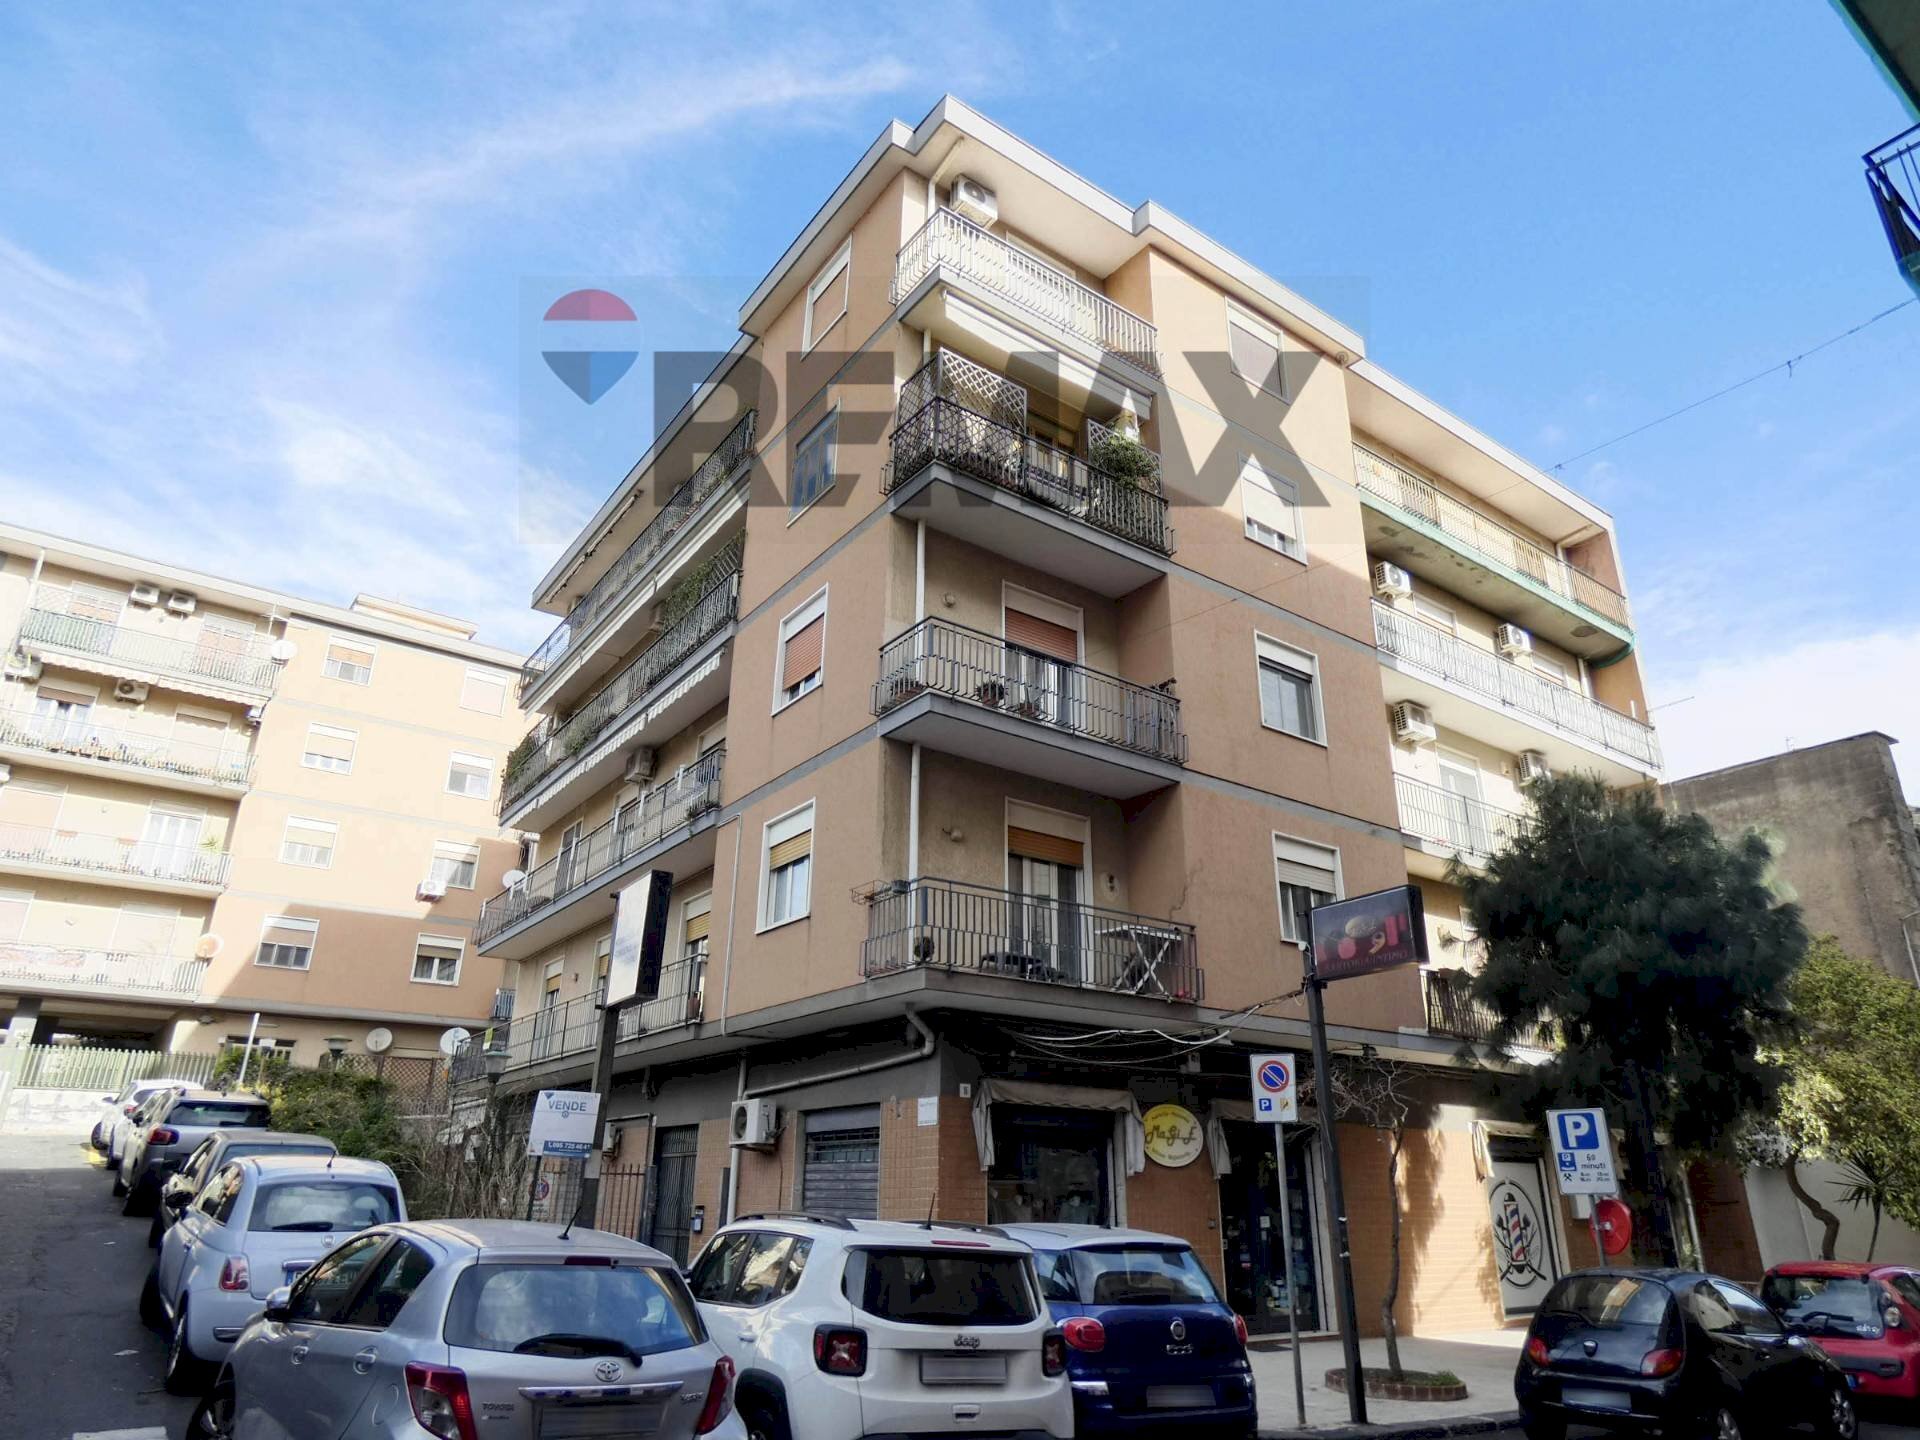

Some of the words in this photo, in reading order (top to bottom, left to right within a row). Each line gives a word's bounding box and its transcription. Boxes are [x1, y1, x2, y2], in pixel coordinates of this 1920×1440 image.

[548, 1100, 587, 1112] VENDE
[1261, 1100, 1269, 1110] P
[1564, 1115, 1590, 1148] P
[954, 1334, 980, 1348] Jeep
[482, 1403, 515, 1411] TOYOTA
